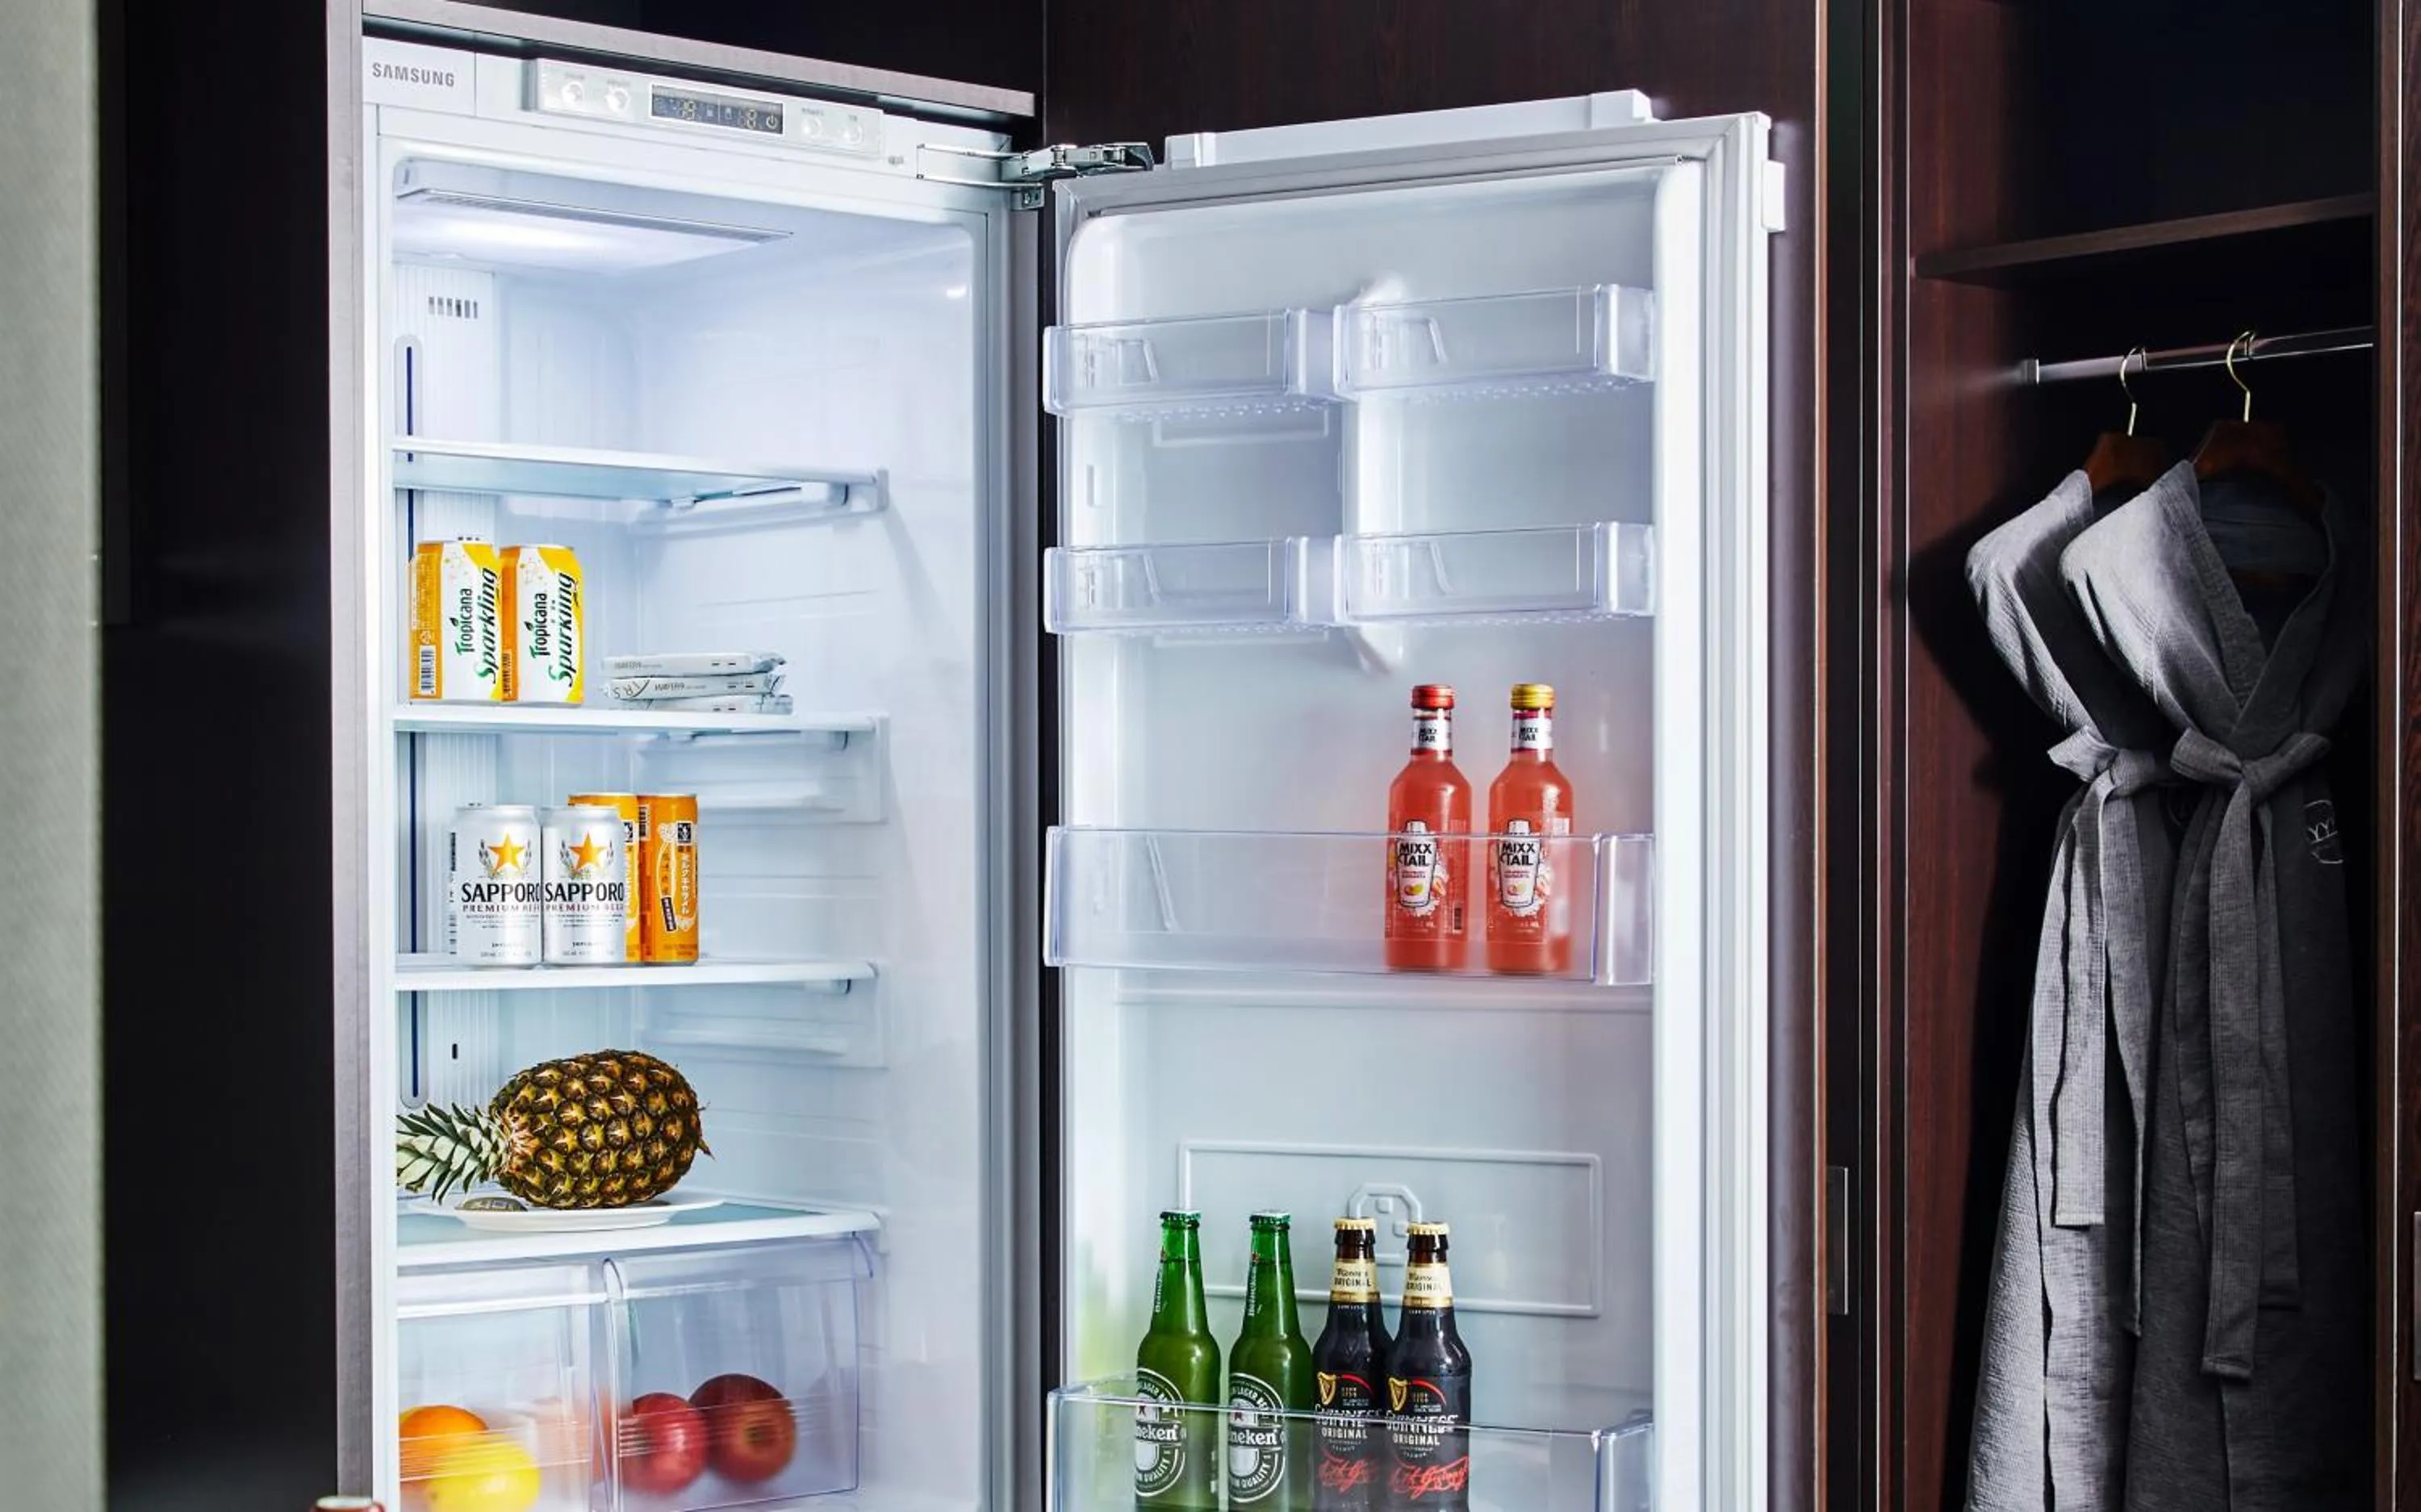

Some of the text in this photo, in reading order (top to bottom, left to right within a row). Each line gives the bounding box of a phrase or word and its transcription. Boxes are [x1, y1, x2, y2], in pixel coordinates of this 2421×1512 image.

[372, 62, 455, 87] SAMSUNG
[450, 588, 475, 656] Tropicana
[476, 567, 500, 684] Sparkling
[525, 592, 550, 659] Tropicana
[549, 573, 579, 687] Sparkling
[1399, 842, 1432, 854] MIXX
[1502, 842, 1536, 854] MIXX
[545, 882, 625, 902] SAPPORO
[1334, 1277, 1371, 1288] ORIGINL
[1407, 1280, 1443, 1292] ORIGIN
[1321, 1426, 1369, 1439] ORIGINAL
[1392, 1433, 1440, 1446] ORIGINAL
[1240, 1462, 1272, 1489] QUALITY
